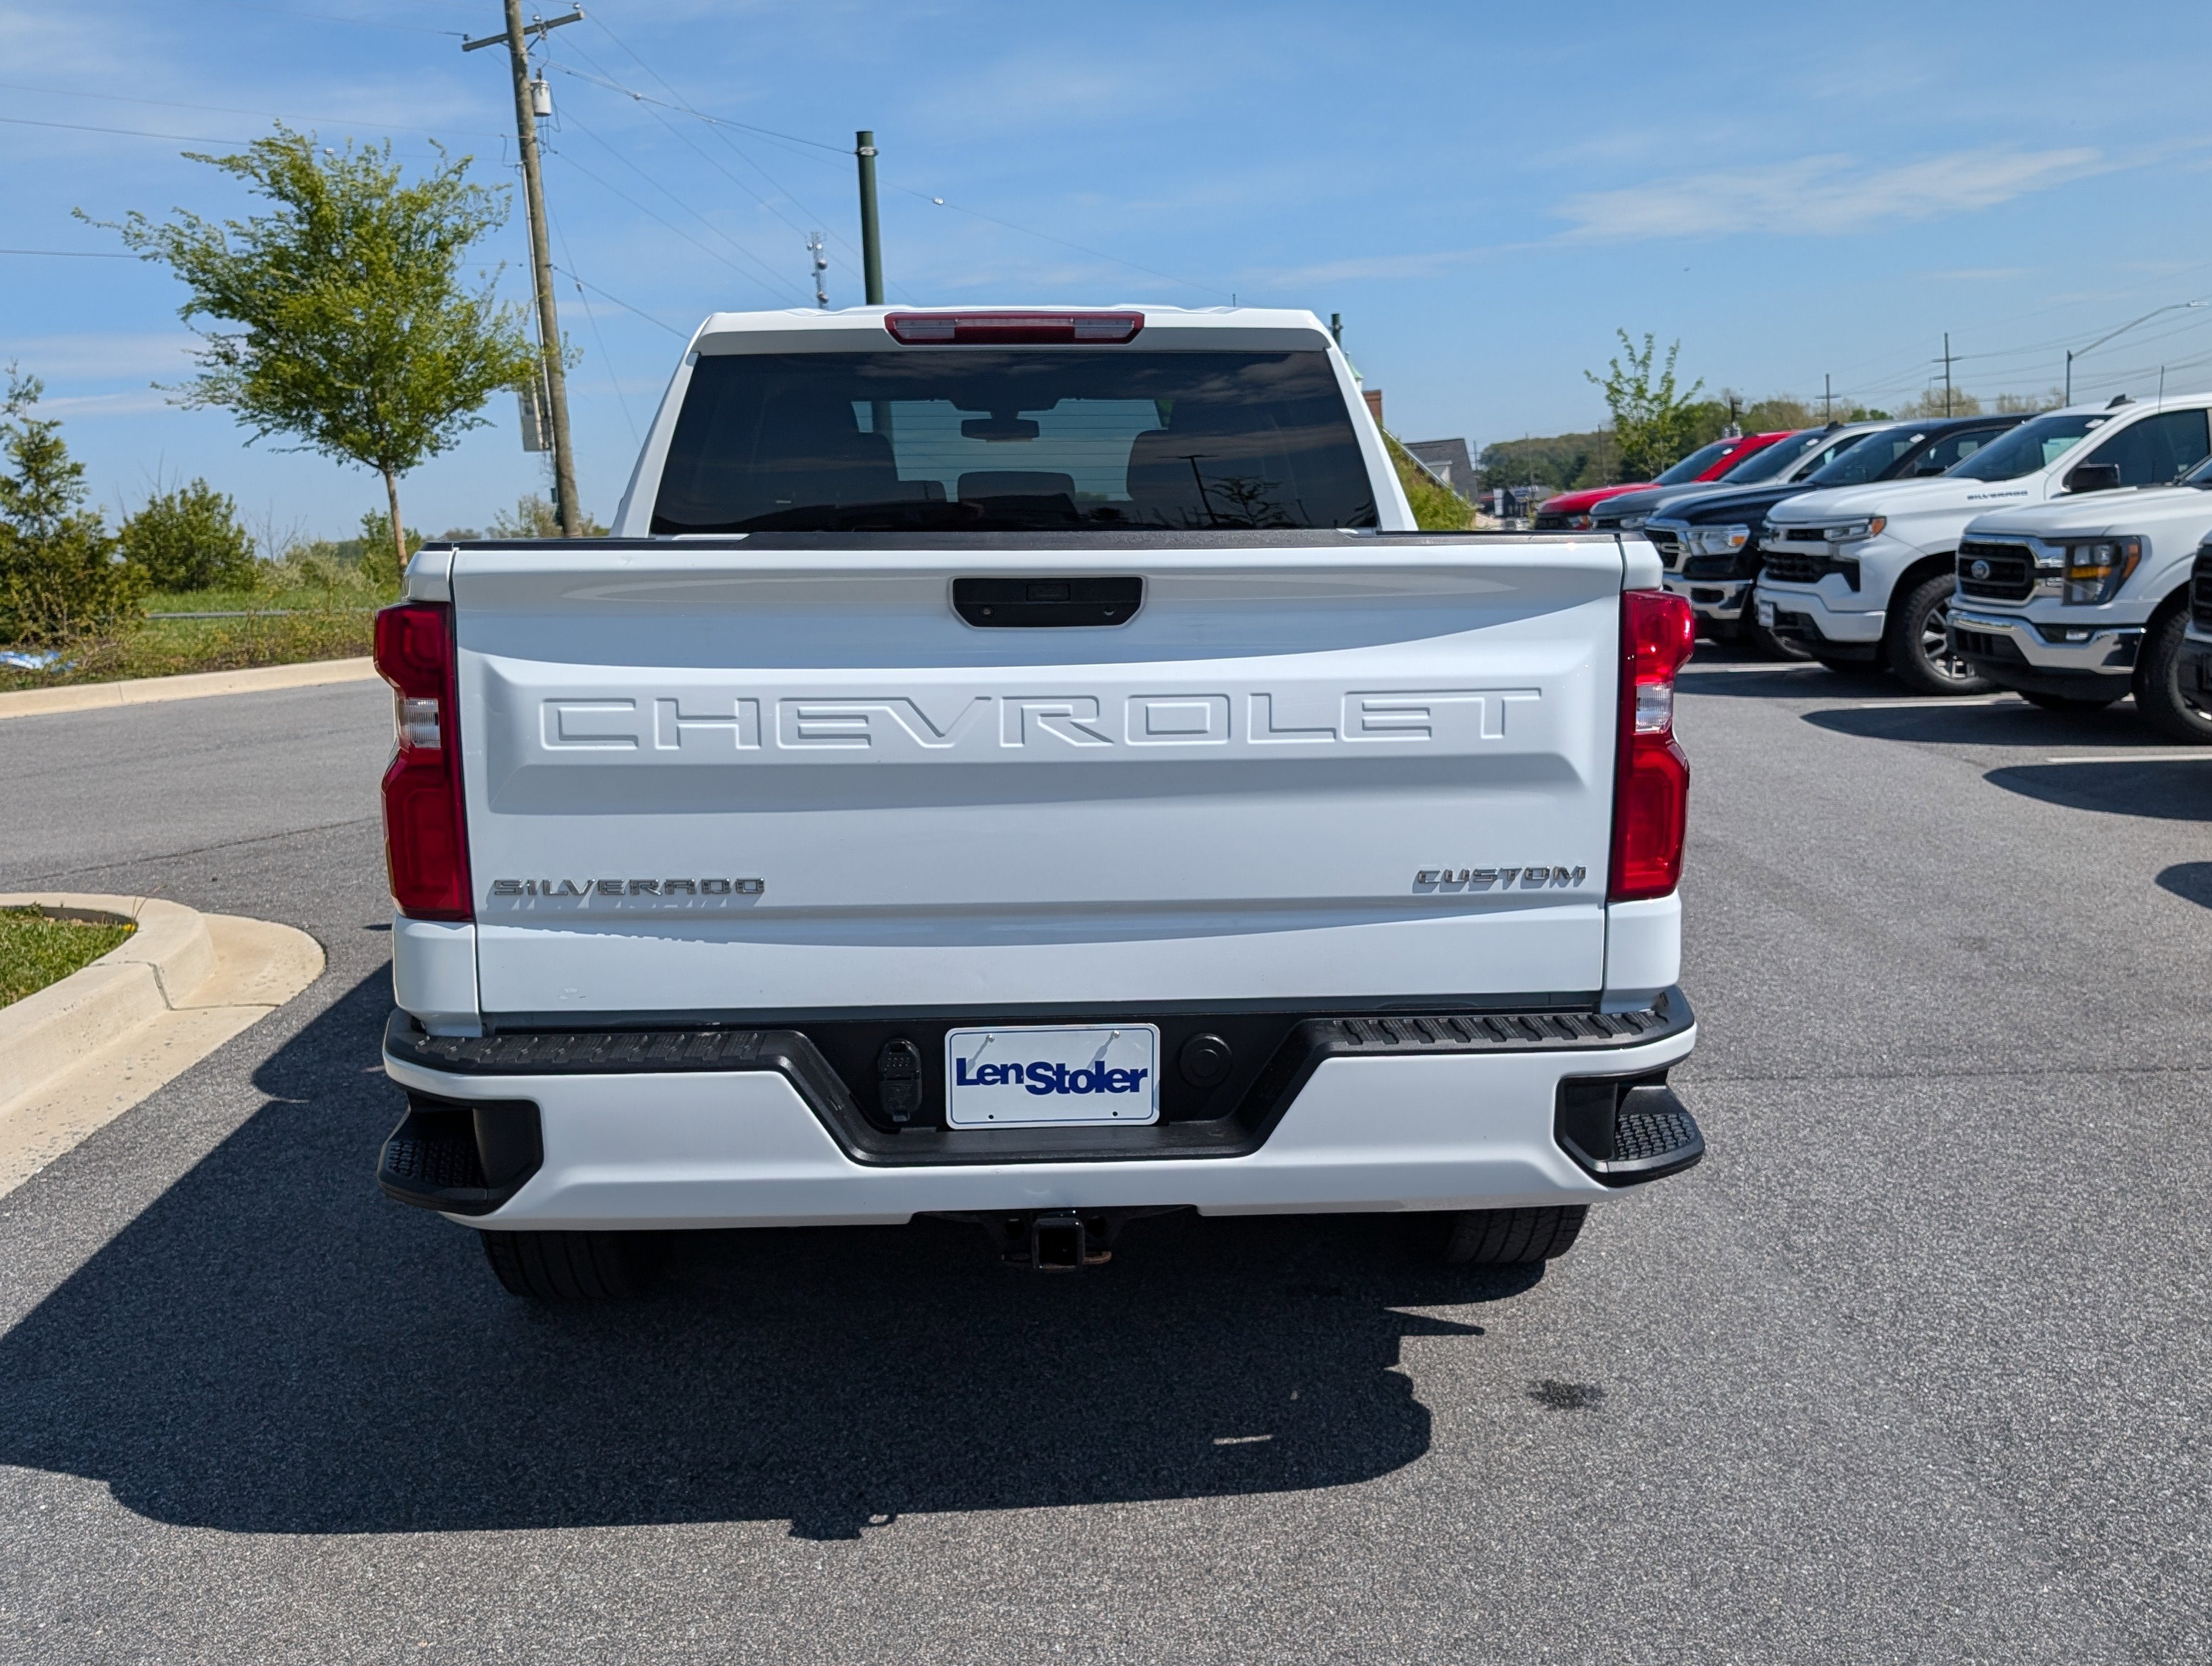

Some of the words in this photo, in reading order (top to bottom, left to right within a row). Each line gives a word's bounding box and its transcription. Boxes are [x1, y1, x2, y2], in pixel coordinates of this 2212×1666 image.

[540, 688, 1541, 751] CHEVROLET
[1417, 866, 1586, 884] CUSTOM
[493, 878, 765, 896] SILVERADO
